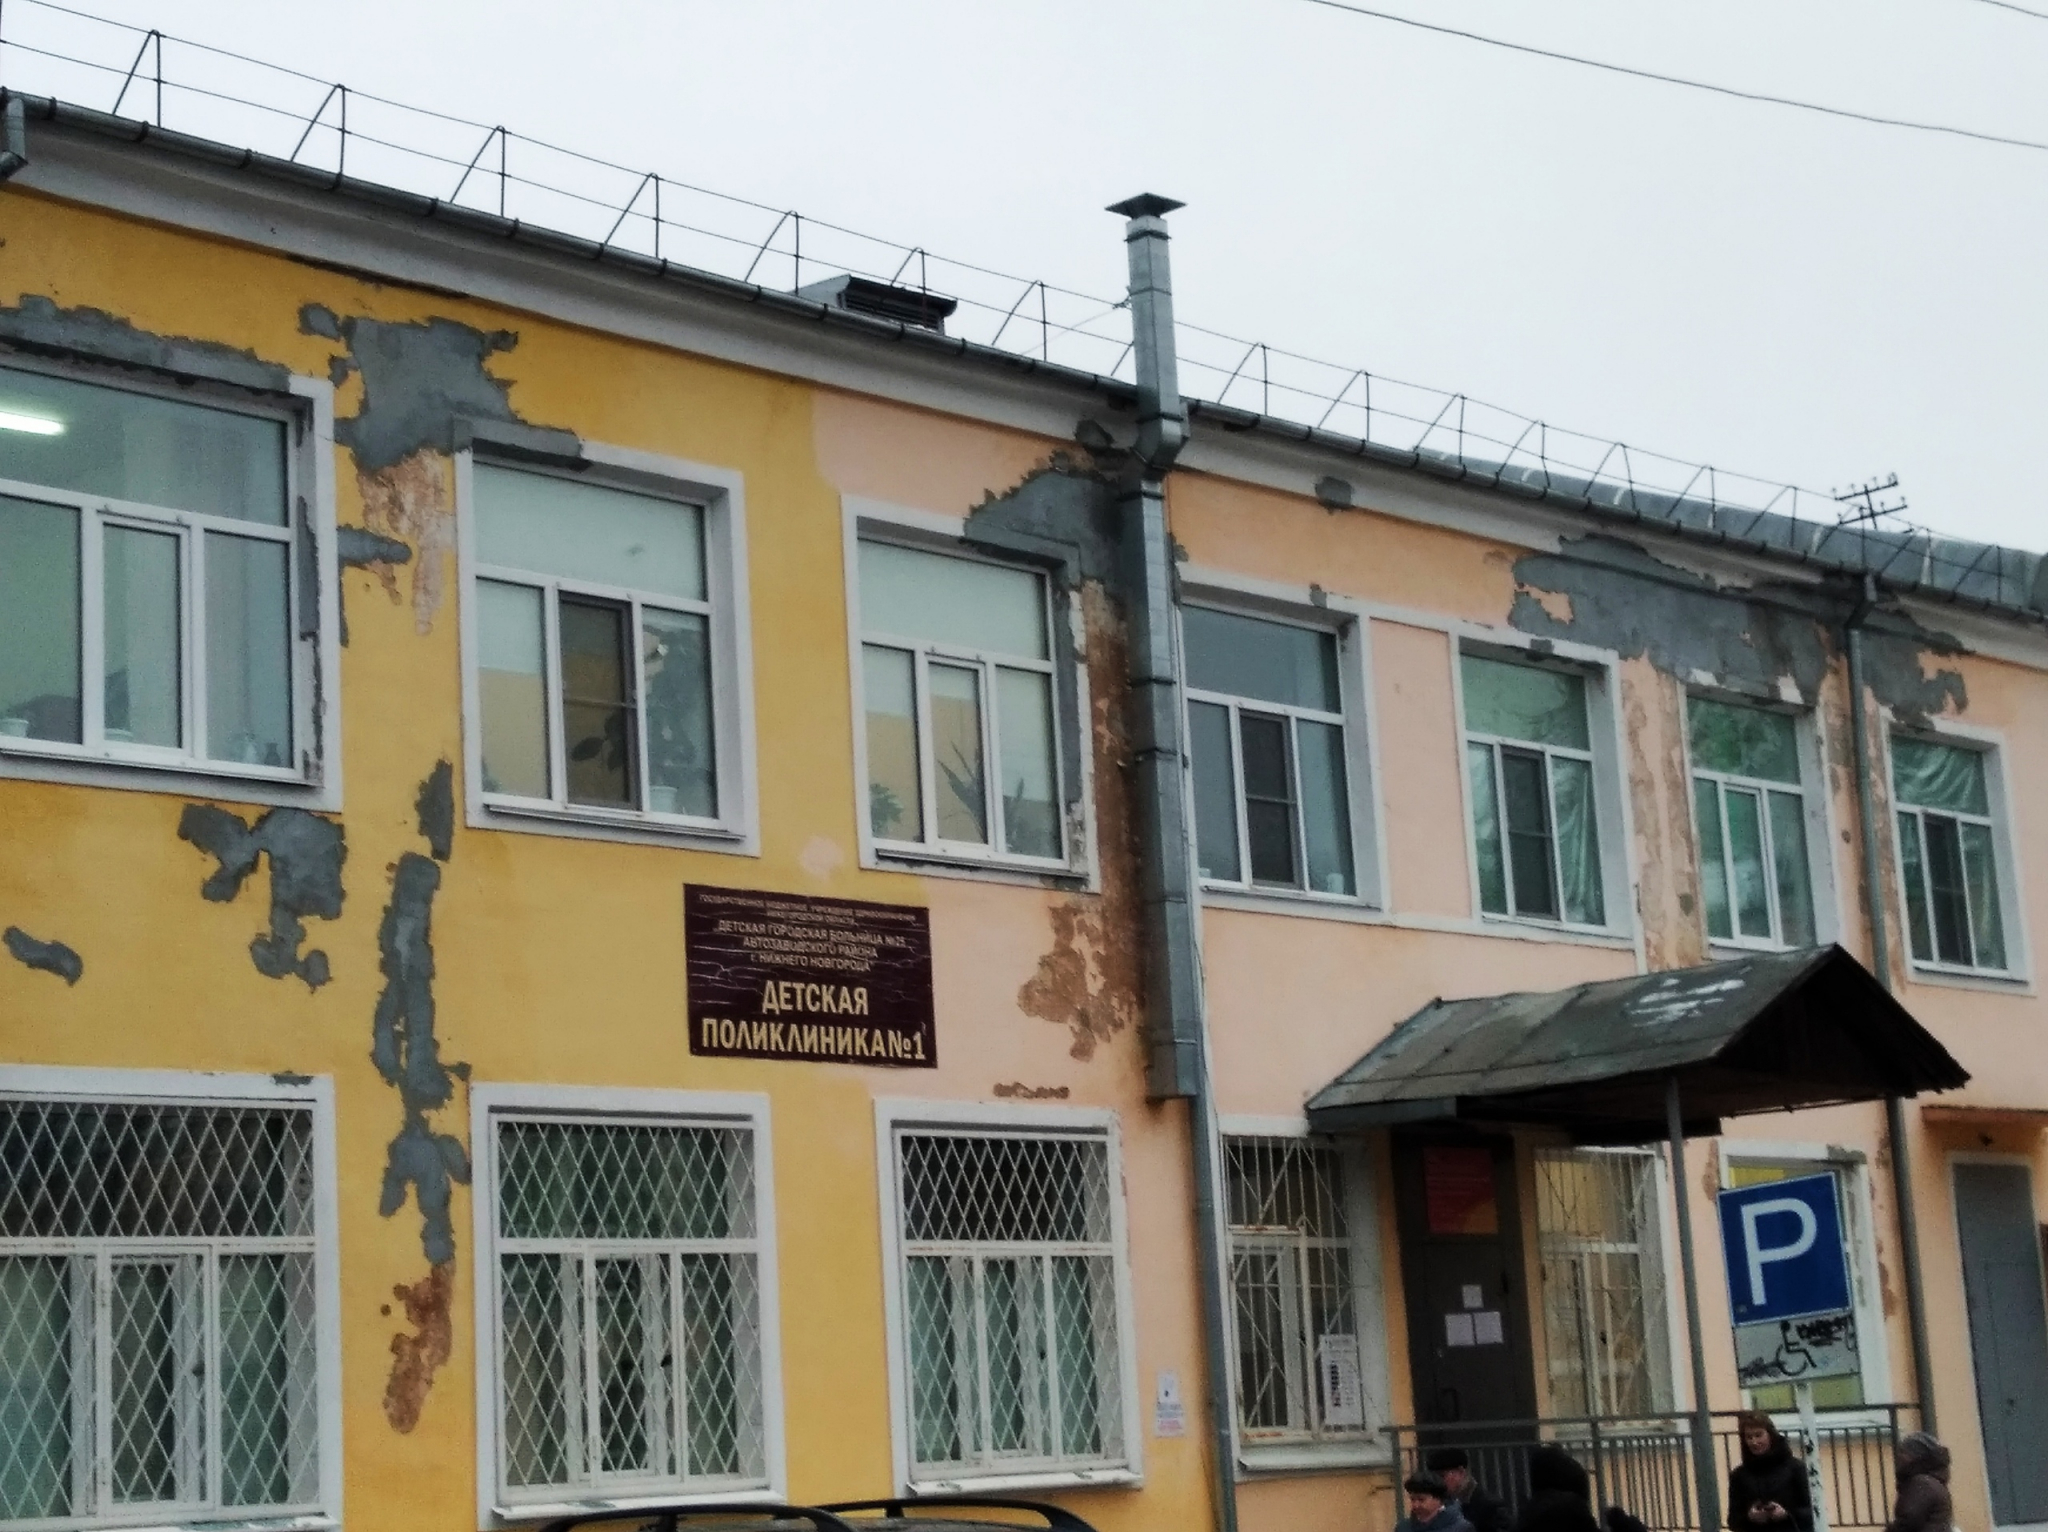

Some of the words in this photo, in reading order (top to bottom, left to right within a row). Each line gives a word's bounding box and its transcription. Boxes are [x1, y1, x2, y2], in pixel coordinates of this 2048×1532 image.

[767, 922, 828, 941] ГОРОДСКАЯ
[829, 929, 884, 945] БОЛЬНИЦА
[743, 936, 837, 954] АВТОЗАВОДСКОГО
[838, 944, 878, 958] РАЙОНА
[759, 954, 808, 967] НИЖНЕГО
[762, 979, 869, 1016] ДЕТСКАЯ
[1741, 1198, 1817, 1306] P
